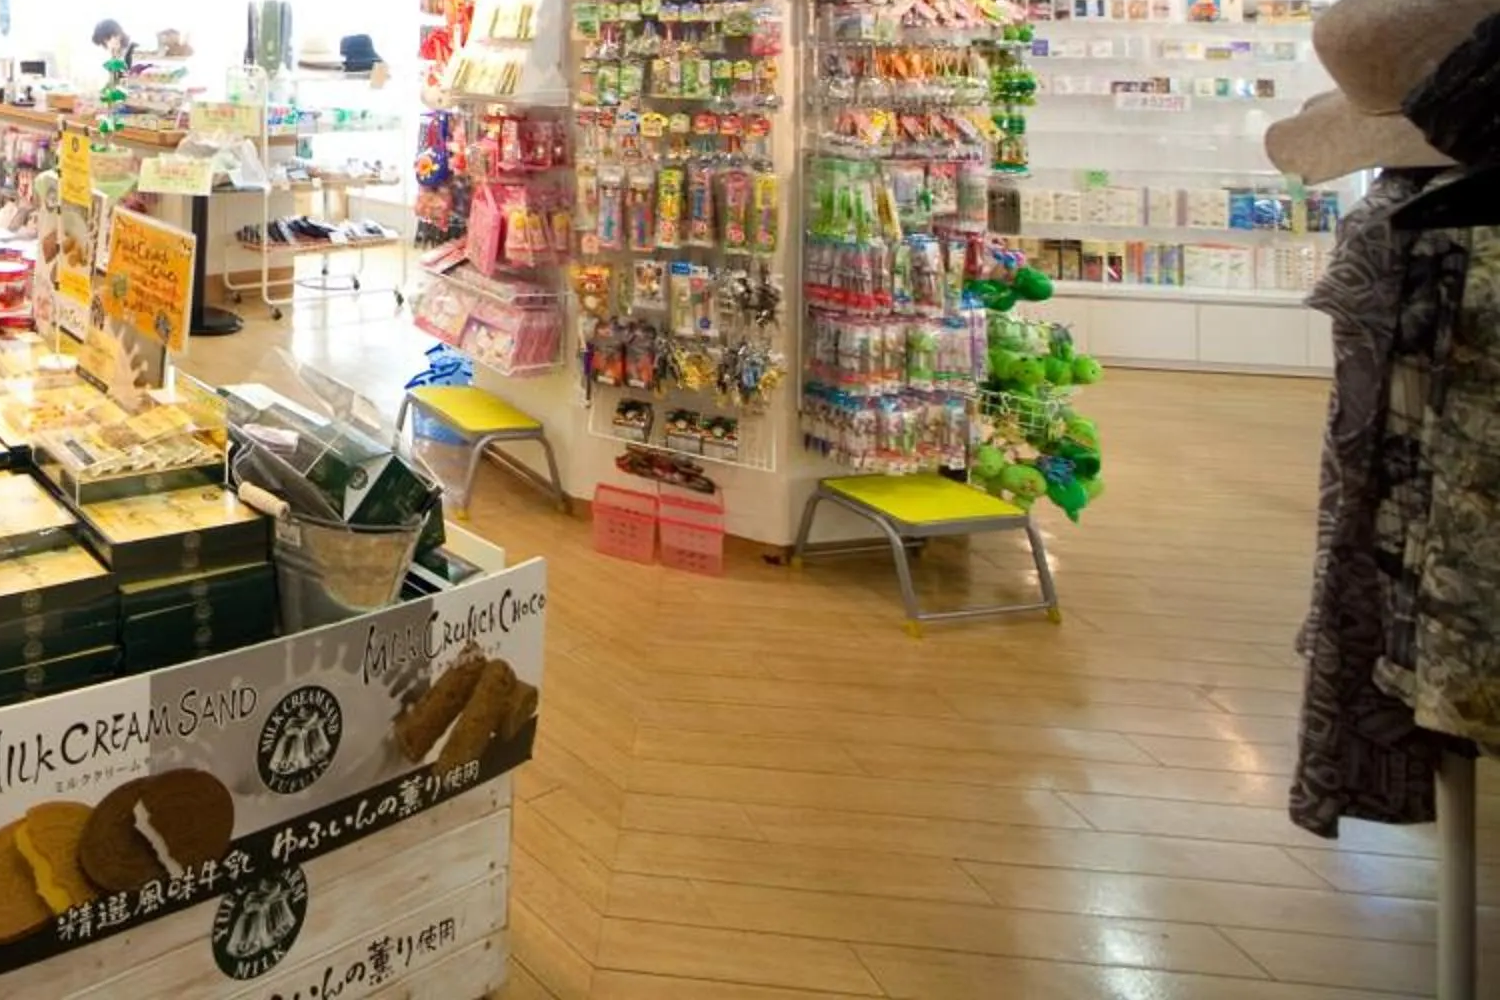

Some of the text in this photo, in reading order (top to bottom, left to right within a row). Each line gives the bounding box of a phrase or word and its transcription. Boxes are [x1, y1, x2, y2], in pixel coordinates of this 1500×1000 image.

[61, 706, 172, 765] CREAM
[178, 686, 258, 738] SAND
[234, 945, 285, 979] MILK
[271, 918, 456, 1000] いんの薫り使用
